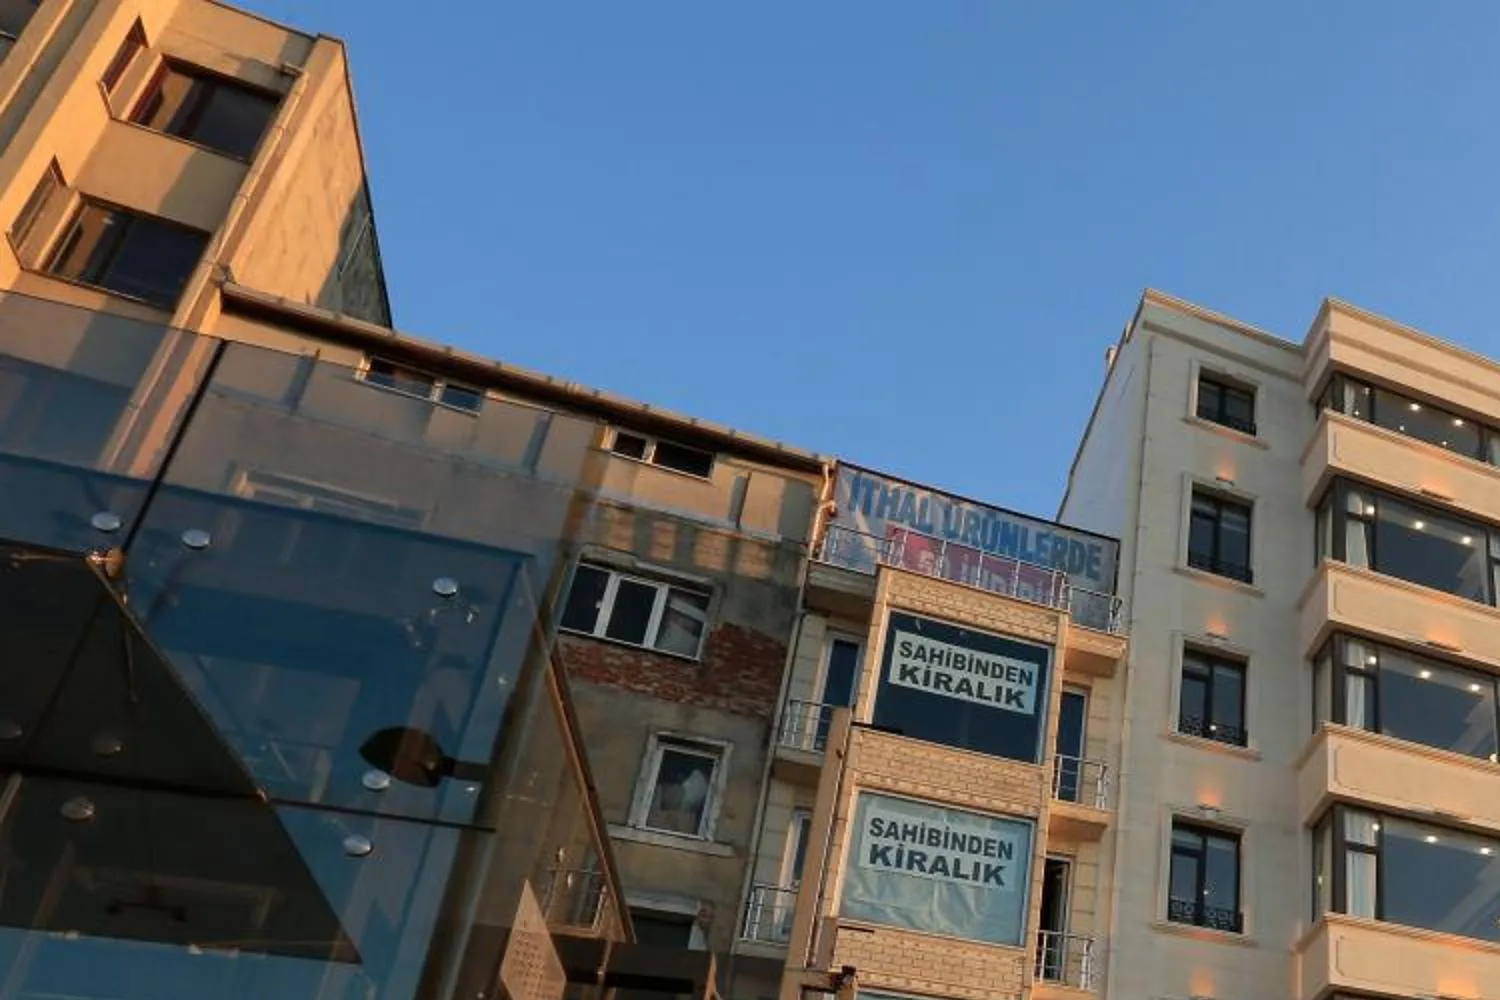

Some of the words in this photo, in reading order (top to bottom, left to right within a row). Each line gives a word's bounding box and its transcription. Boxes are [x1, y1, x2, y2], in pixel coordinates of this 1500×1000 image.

[899, 640, 1033, 687] SAHİBİNDEN
[898, 664, 1025, 709] KİRALIK
[869, 817, 1014, 860] SAHİBİNDEN
[869, 843, 1007, 887] KİRALIK
